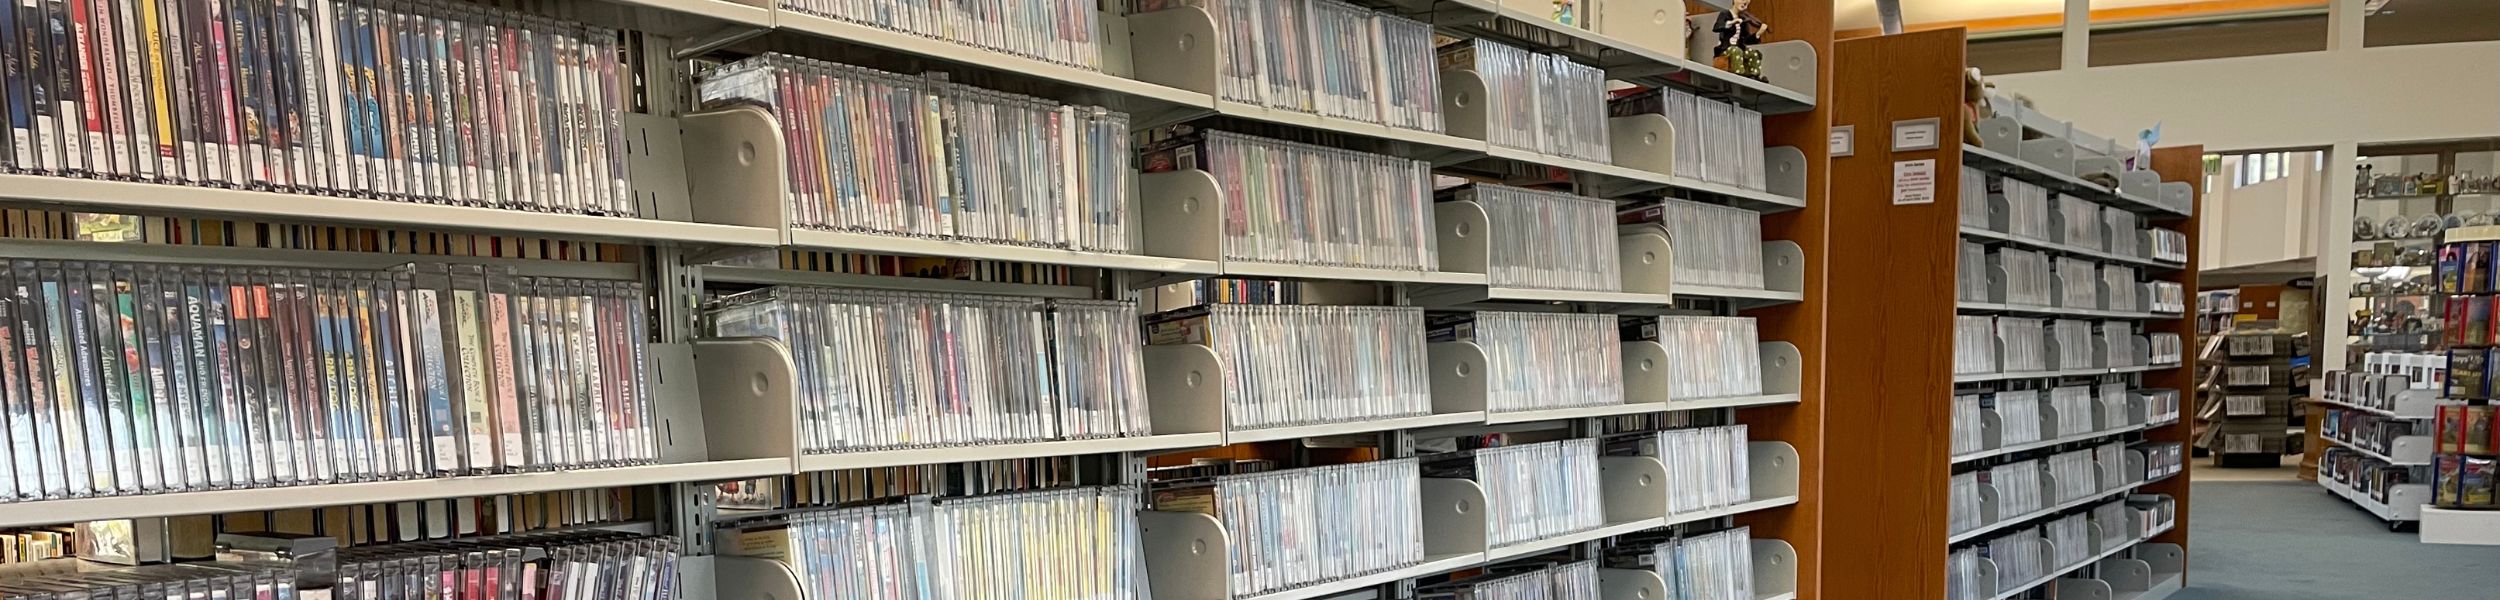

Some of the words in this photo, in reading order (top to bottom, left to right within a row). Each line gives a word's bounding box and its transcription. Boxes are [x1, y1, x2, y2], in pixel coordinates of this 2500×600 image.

[75, 23, 88, 70] ALEXANDER
[99, 18, 112, 74] WONDERLAND
[110, 83, 120, 135] THUMBELINA
[302, 51, 313, 87] ROADS
[457, 60, 465, 85] ALPHA
[305, 88, 317, 114] LEAD
[402, 58, 410, 86] ALPHA
[411, 127, 419, 159] FAMILY
[420, 59, 429, 86] ALPHA
[430, 128, 438, 160] FAMILY
[309, 115, 322, 152] HOME
[75, 309, 86, 345] Animated
[188, 296, 206, 358] AQUAMAN
[587, 331, 598, 354] BAG
[79, 346, 92, 387] Adventures
[172, 341, 182, 371] APPLE
[197, 360, 206, 375] AND
[461, 347, 473, 392] COLLECTION
[494, 344, 505, 388] COLLECTION
[175, 373, 185, 386] OF
[178, 387, 187, 402] MY
[199, 377, 210, 408] FRIENDS
[385, 359, 399, 410] ARCHIE
[591, 364, 602, 414] MARBLES
[329, 386, 340, 412] DOG
[349, 386, 360, 412] DOG
